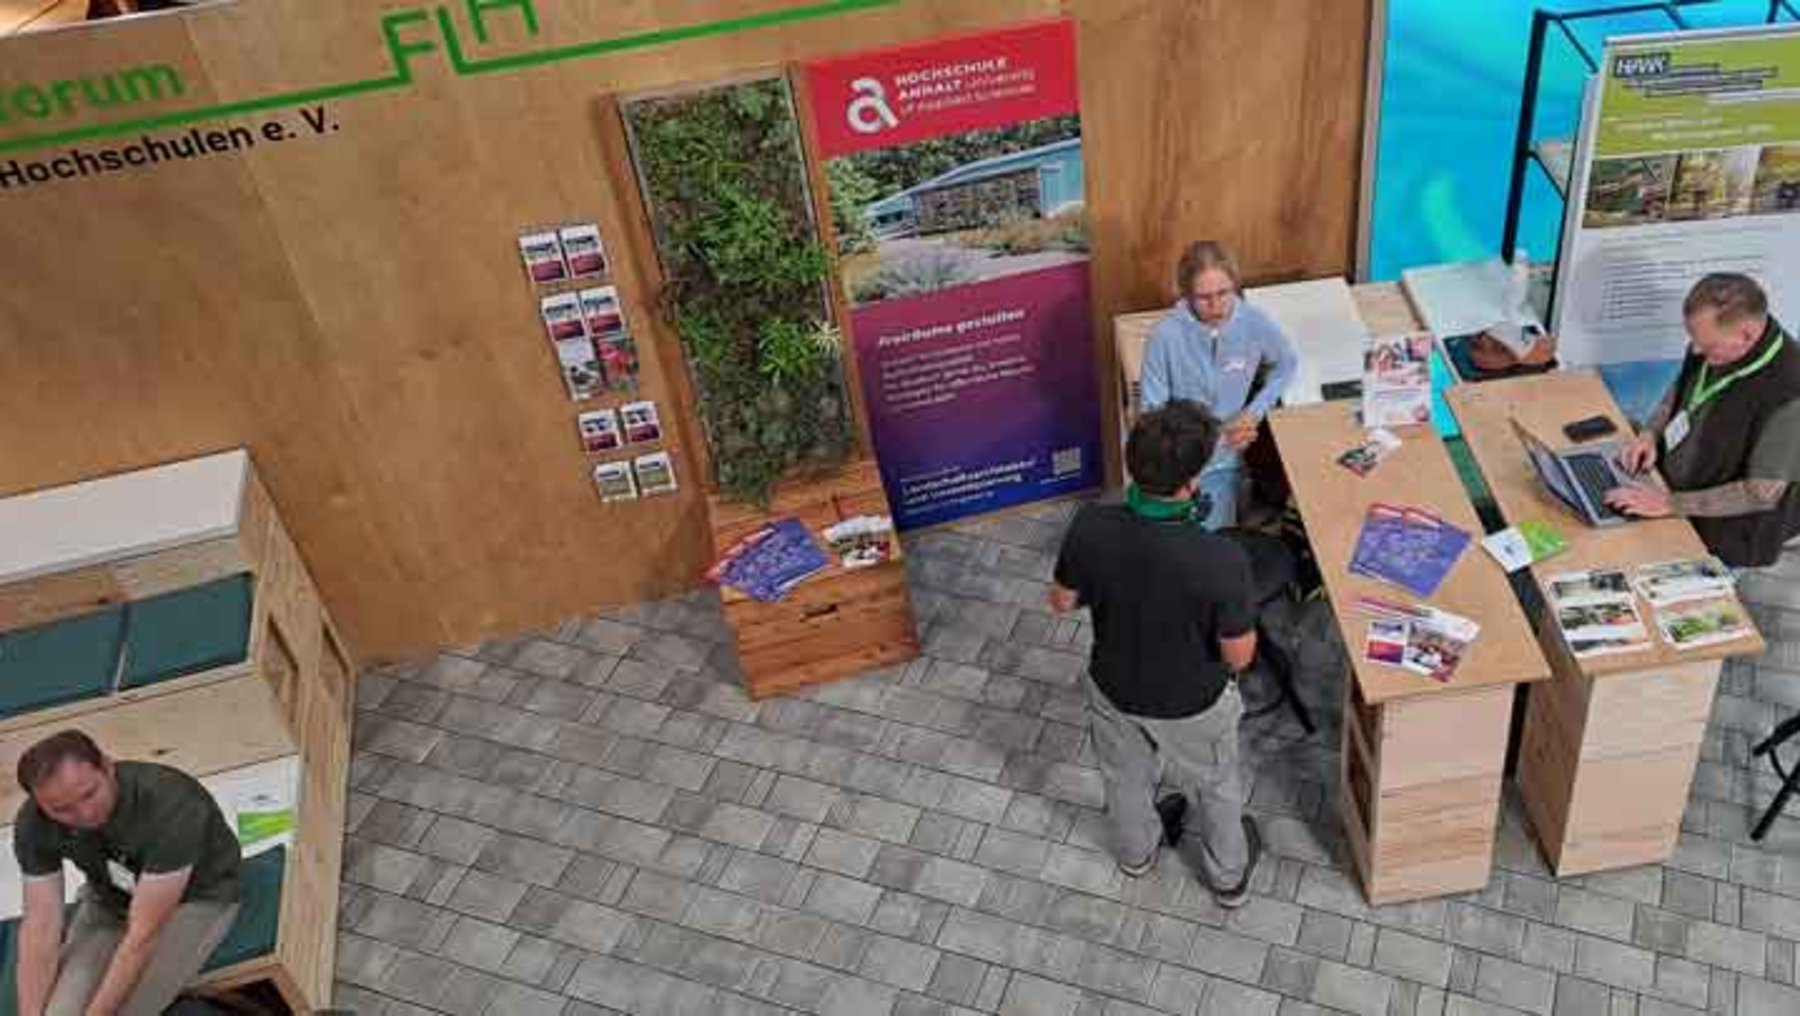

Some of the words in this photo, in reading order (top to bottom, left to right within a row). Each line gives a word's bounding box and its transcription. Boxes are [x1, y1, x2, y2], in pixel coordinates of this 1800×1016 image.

[894, 57, 1007, 88] HOCHSCHULE
[897, 79, 962, 101] ANHALT
[0, 128, 254, 188] Hochschulen
[261, 121, 297, 142] e.
[300, 106, 339, 134] V.
[956, 308, 1026, 335] gestalten
